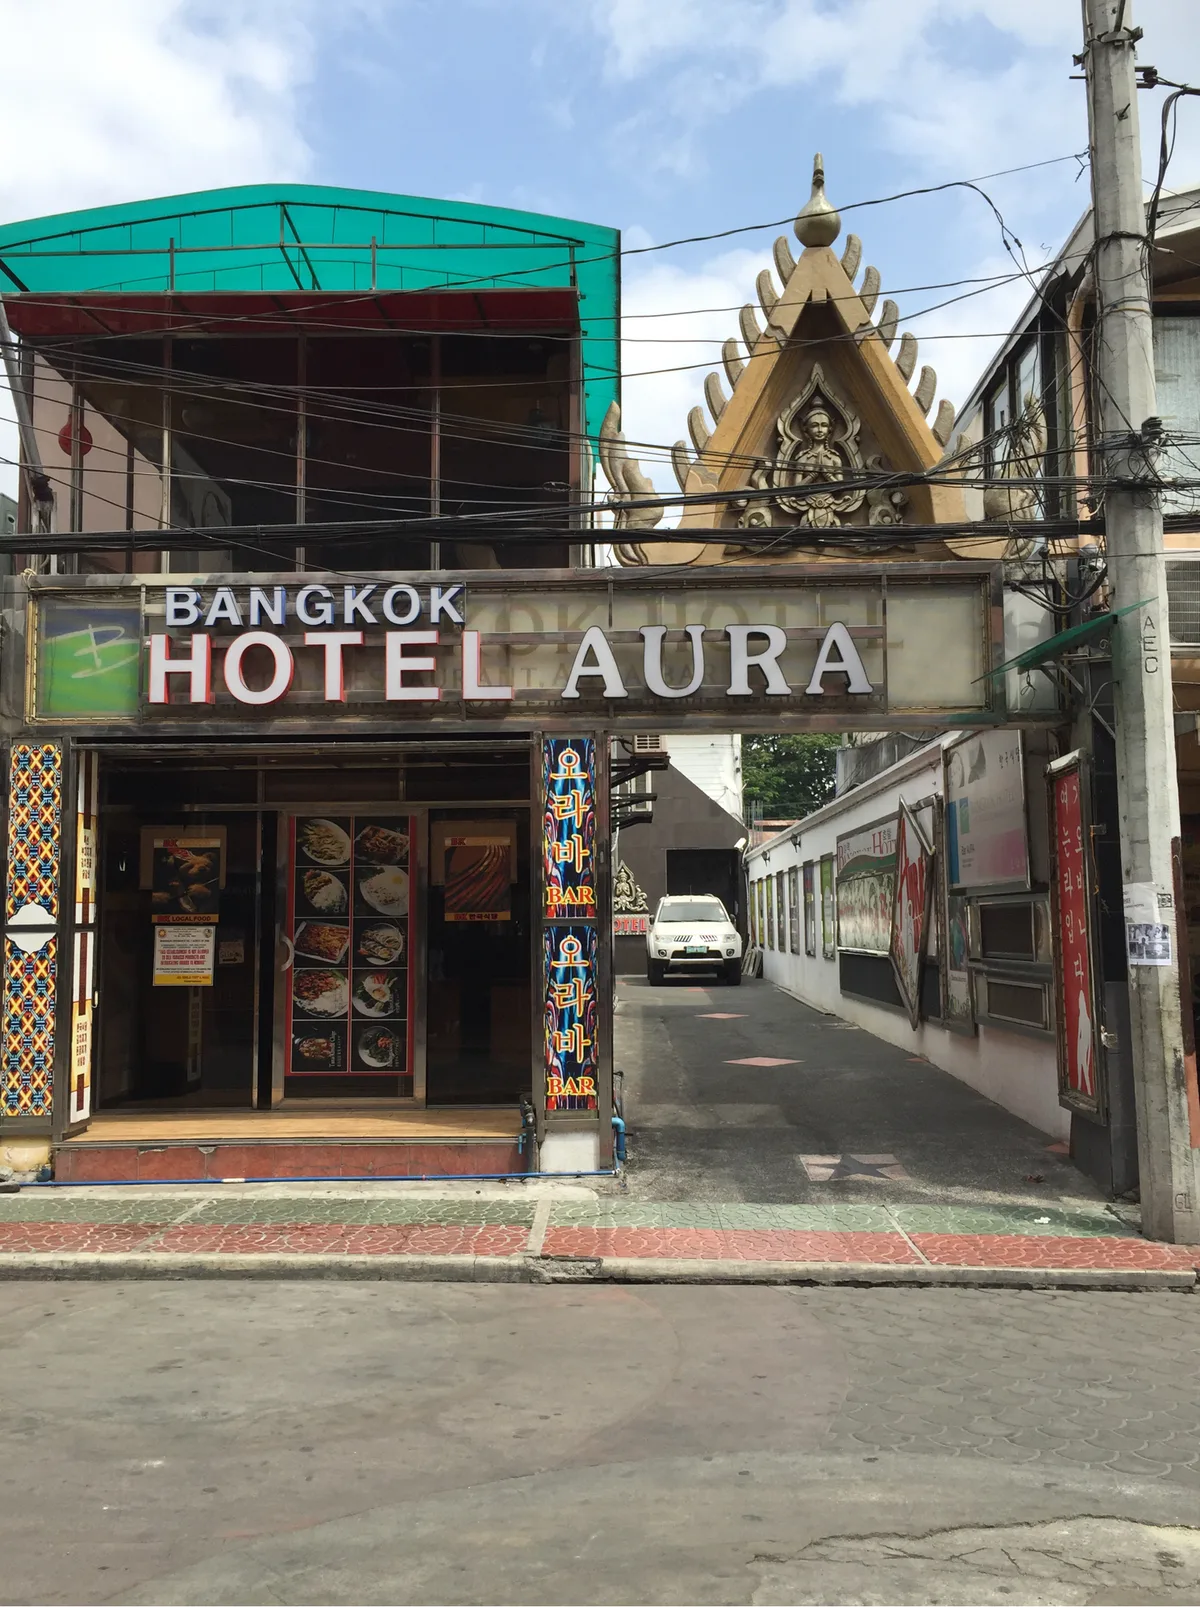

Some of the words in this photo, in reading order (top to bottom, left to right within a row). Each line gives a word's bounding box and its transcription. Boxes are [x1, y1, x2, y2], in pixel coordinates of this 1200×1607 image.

[164, 585, 466, 627] BANGKOK
[147, 630, 513, 705] HOTEL
[561, 621, 873, 699] AURA
[1143, 615, 1158, 673] AEC
[550, 748, 590, 874] 오라바
[546, 885, 595, 905] BAR
[551, 934, 591, 1064] 오라바
[547, 1076, 596, 1096] BAR
